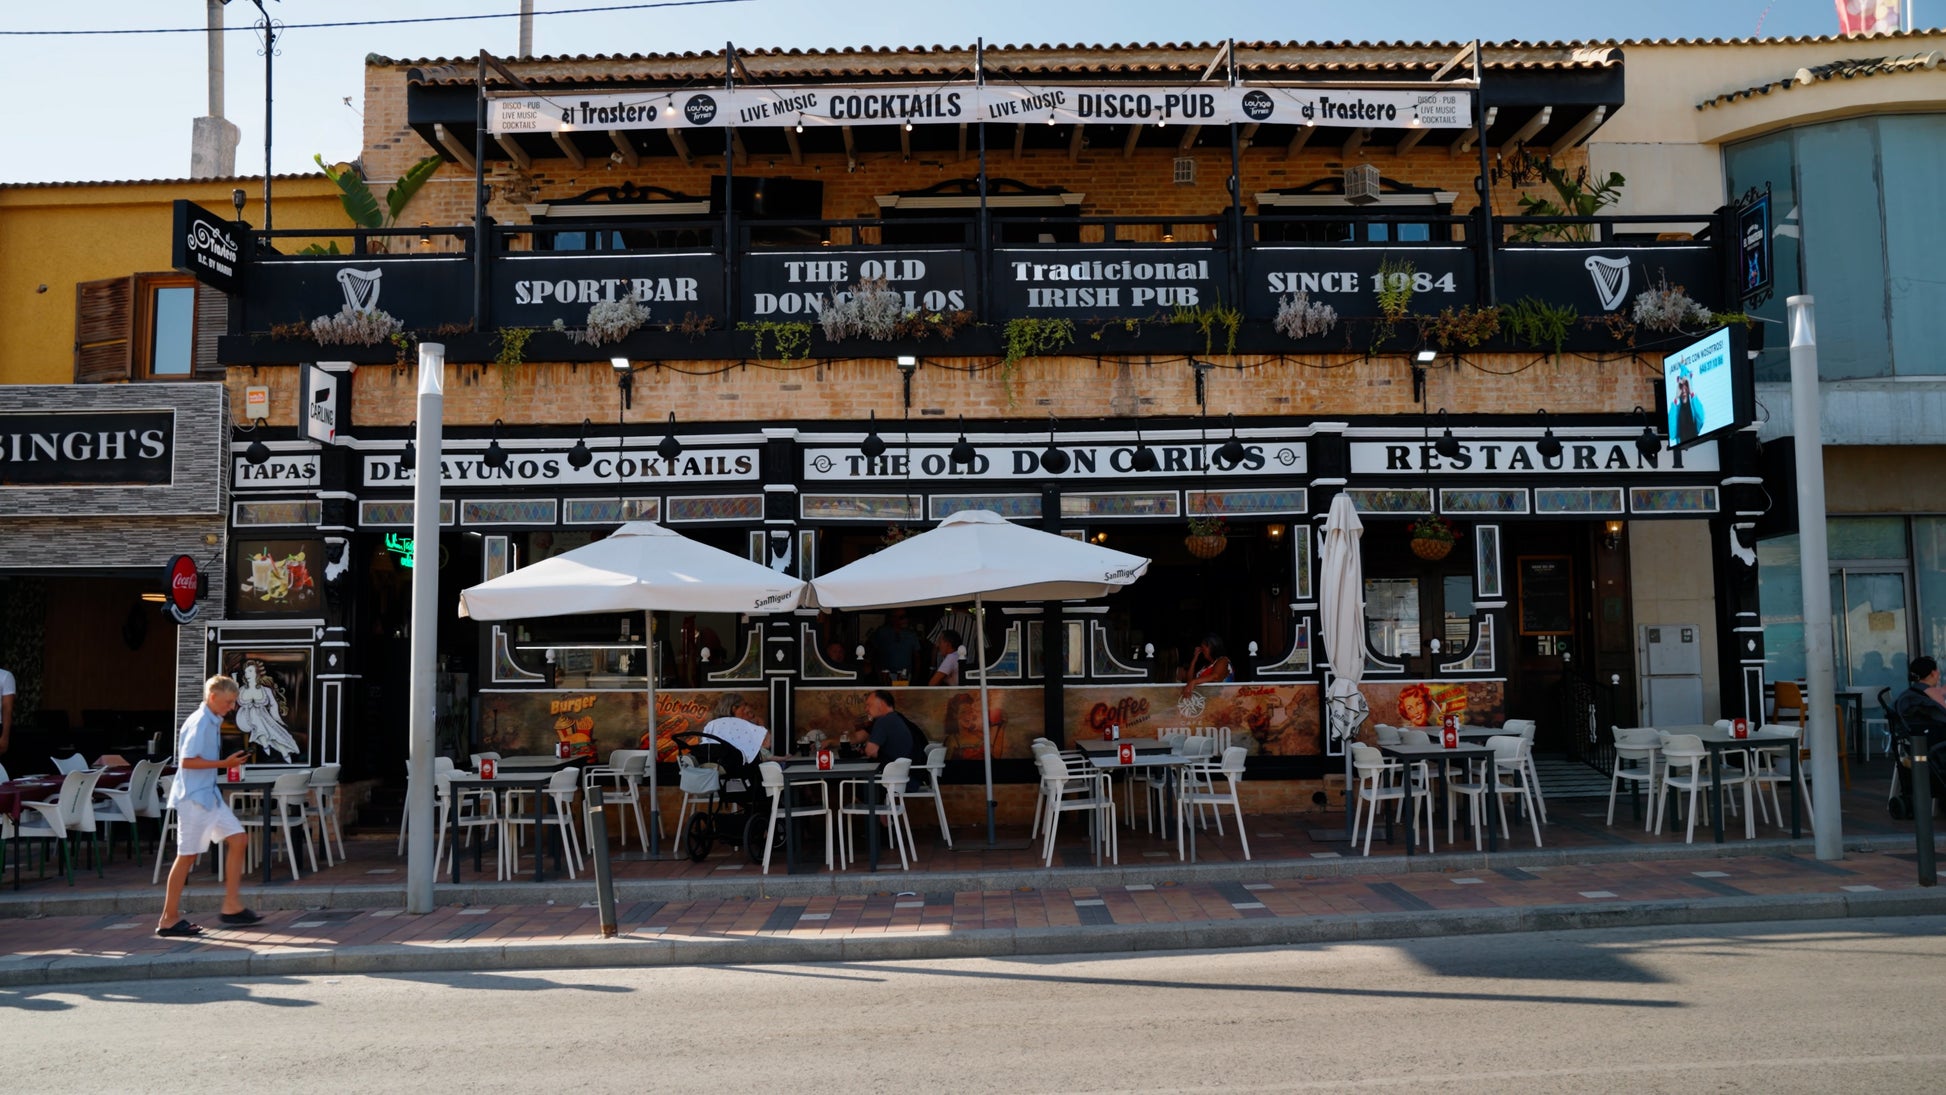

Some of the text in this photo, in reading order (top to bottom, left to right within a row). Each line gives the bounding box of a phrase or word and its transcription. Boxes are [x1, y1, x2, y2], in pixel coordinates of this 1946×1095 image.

[528, 101, 540, 109] PUB
[740, 92, 818, 123] LIVE MUSIC
[829, 92, 962, 119] COCKTAILS
[988, 90, 1066, 118] LIVE MUSIC
[1078, 93, 1216, 118] DISCO-PUB
[1320, 96, 1397, 120] Trastero
[1418, 96, 1437, 104] DISCO
[1442, 96, 1456, 104] PUB
[1420, 106, 1456, 114] LIVE MUSIC
[517, 111, 537, 119] MUSIC
[562, 102, 658, 124] el Trastero
[1422, 116, 1457, 124] COCKTAILS
[502, 121, 536, 129] COCKTAILS
[784, 259, 926, 282] THE OLD
[1011, 260, 1209, 281] Tradicional
[514, 277, 698, 304] SPORT BAR
[1267, 272, 1457, 293] SINCE 1984
[754, 290, 965, 315] DON CLOS
[1027, 287, 1200, 308] IRISH PUB
[310, 402, 333, 426] CARLING
[0, 429, 165, 462] INGH'S
[1386, 444, 1688, 470] RESTAURANT
[240, 463, 317, 480] TAPAS
[370, 455, 752, 481] DEAYUNOS COKTAILS
[845, 454, 910, 476] THE
[921, 454, 990, 476] OLD
[550, 695, 597, 715] Burger
[656, 694, 708, 719] Hot dog
[1090, 696, 1149, 730] Coffee
